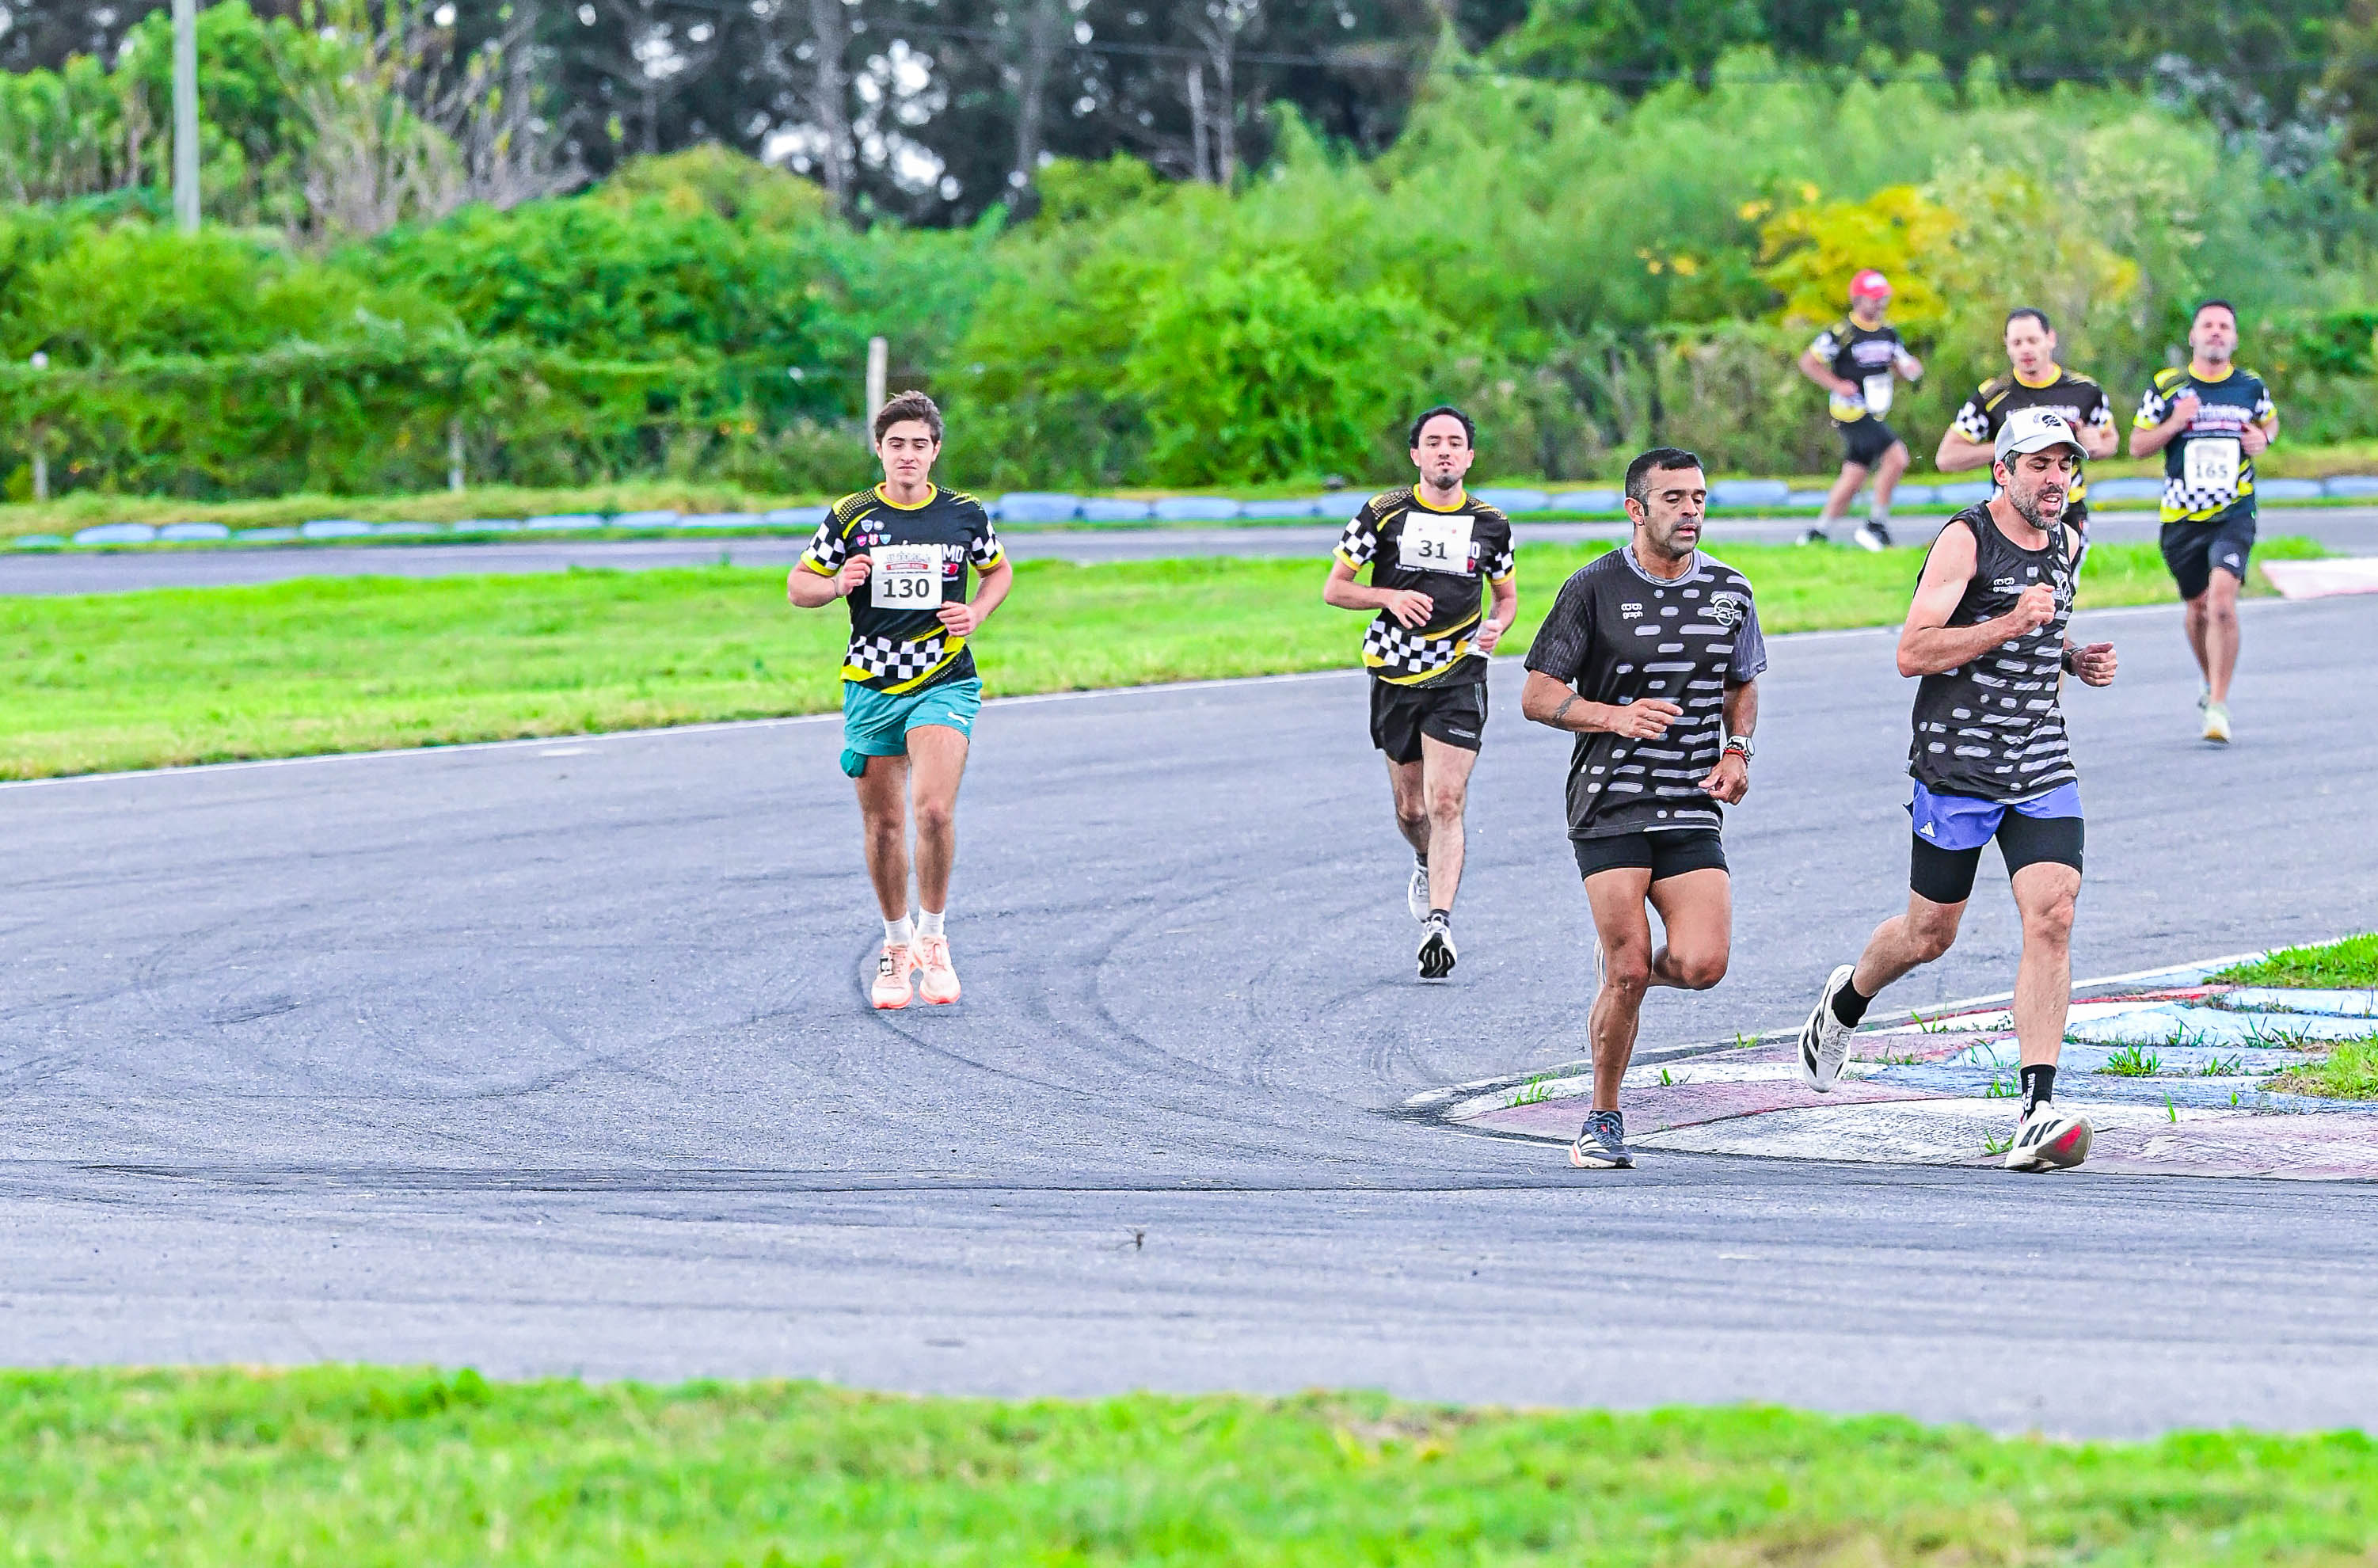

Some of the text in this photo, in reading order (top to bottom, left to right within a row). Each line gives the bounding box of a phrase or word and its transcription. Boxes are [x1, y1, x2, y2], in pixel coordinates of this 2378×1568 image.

[2195, 463, 2228, 478] 165
[1418, 539, 1448, 560] 31
[883, 578, 930, 598] 130
